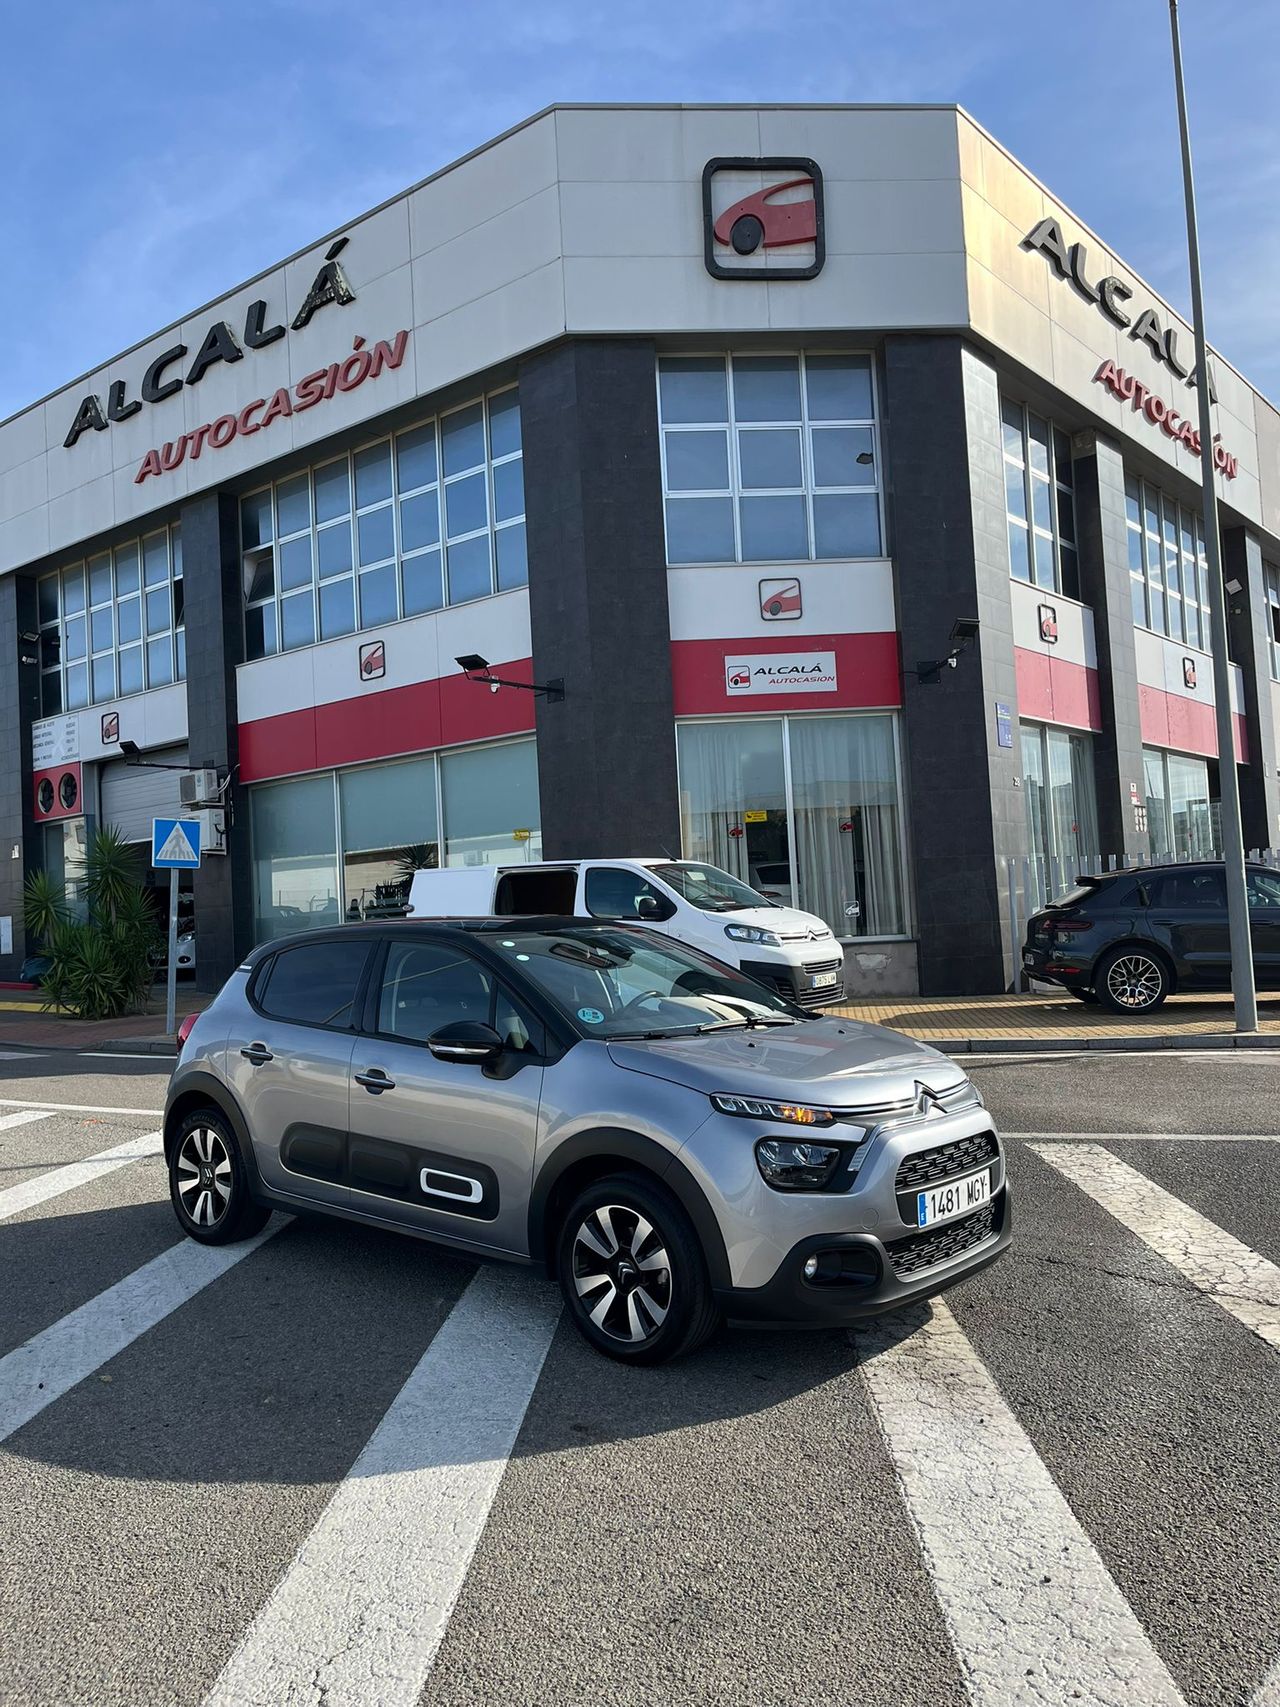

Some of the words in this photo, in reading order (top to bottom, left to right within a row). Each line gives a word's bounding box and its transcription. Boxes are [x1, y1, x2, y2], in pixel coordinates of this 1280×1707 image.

[63, 237, 356, 449] ALCALÁ
[134, 329, 409, 483] AUTOCASIÓN
[1093, 359, 1239, 480] AUTOCAÓN
[753, 663, 822, 675] ALCALÁ
[931, 1186, 960, 1219] 1481
[967, 1175, 986, 1206] MGY
